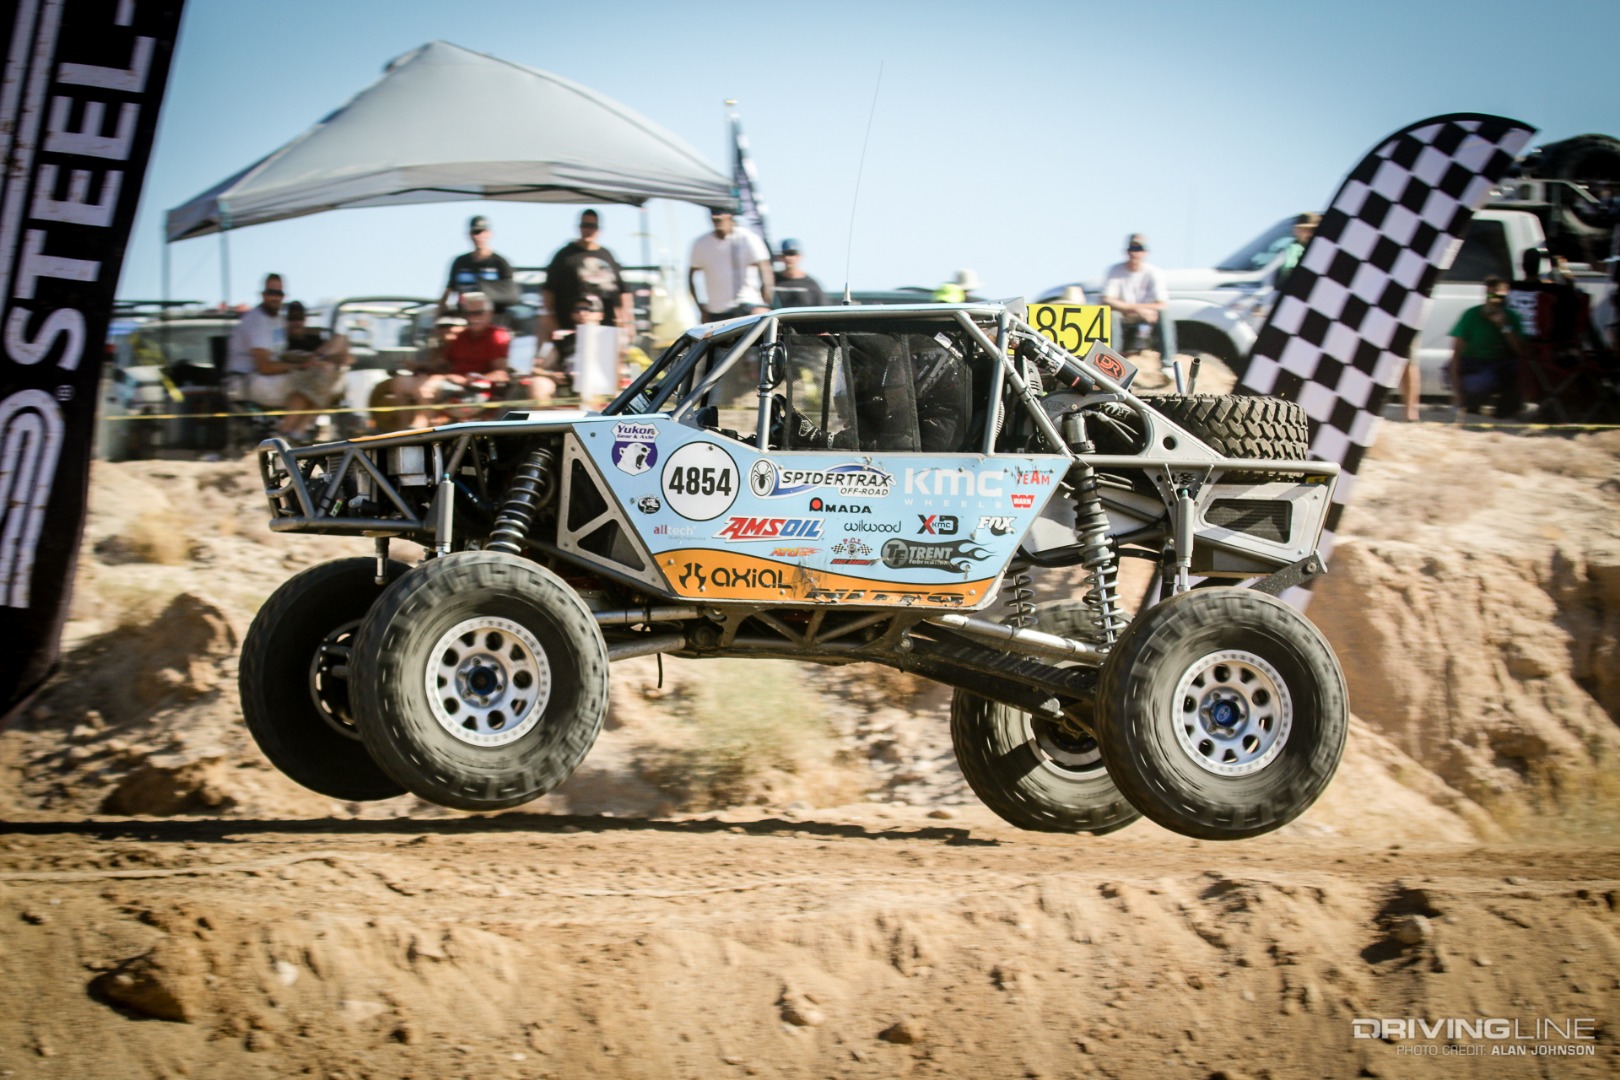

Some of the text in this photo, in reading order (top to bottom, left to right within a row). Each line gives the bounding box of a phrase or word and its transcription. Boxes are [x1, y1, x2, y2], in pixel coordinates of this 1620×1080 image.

[1026, 306, 1109, 353] 854
[669, 466, 732, 496] 4854
[782, 471, 893, 487] SPIDERTRAX
[1017, 470, 1050, 486] TEAM
[840, 487, 889, 496] OFF-ROAD
[720, 517, 821, 539] AMSOIL
[844, 520, 901, 533] wilwood
[977, 515, 1017, 535] FOX
[909, 547, 953, 560] TRENT
